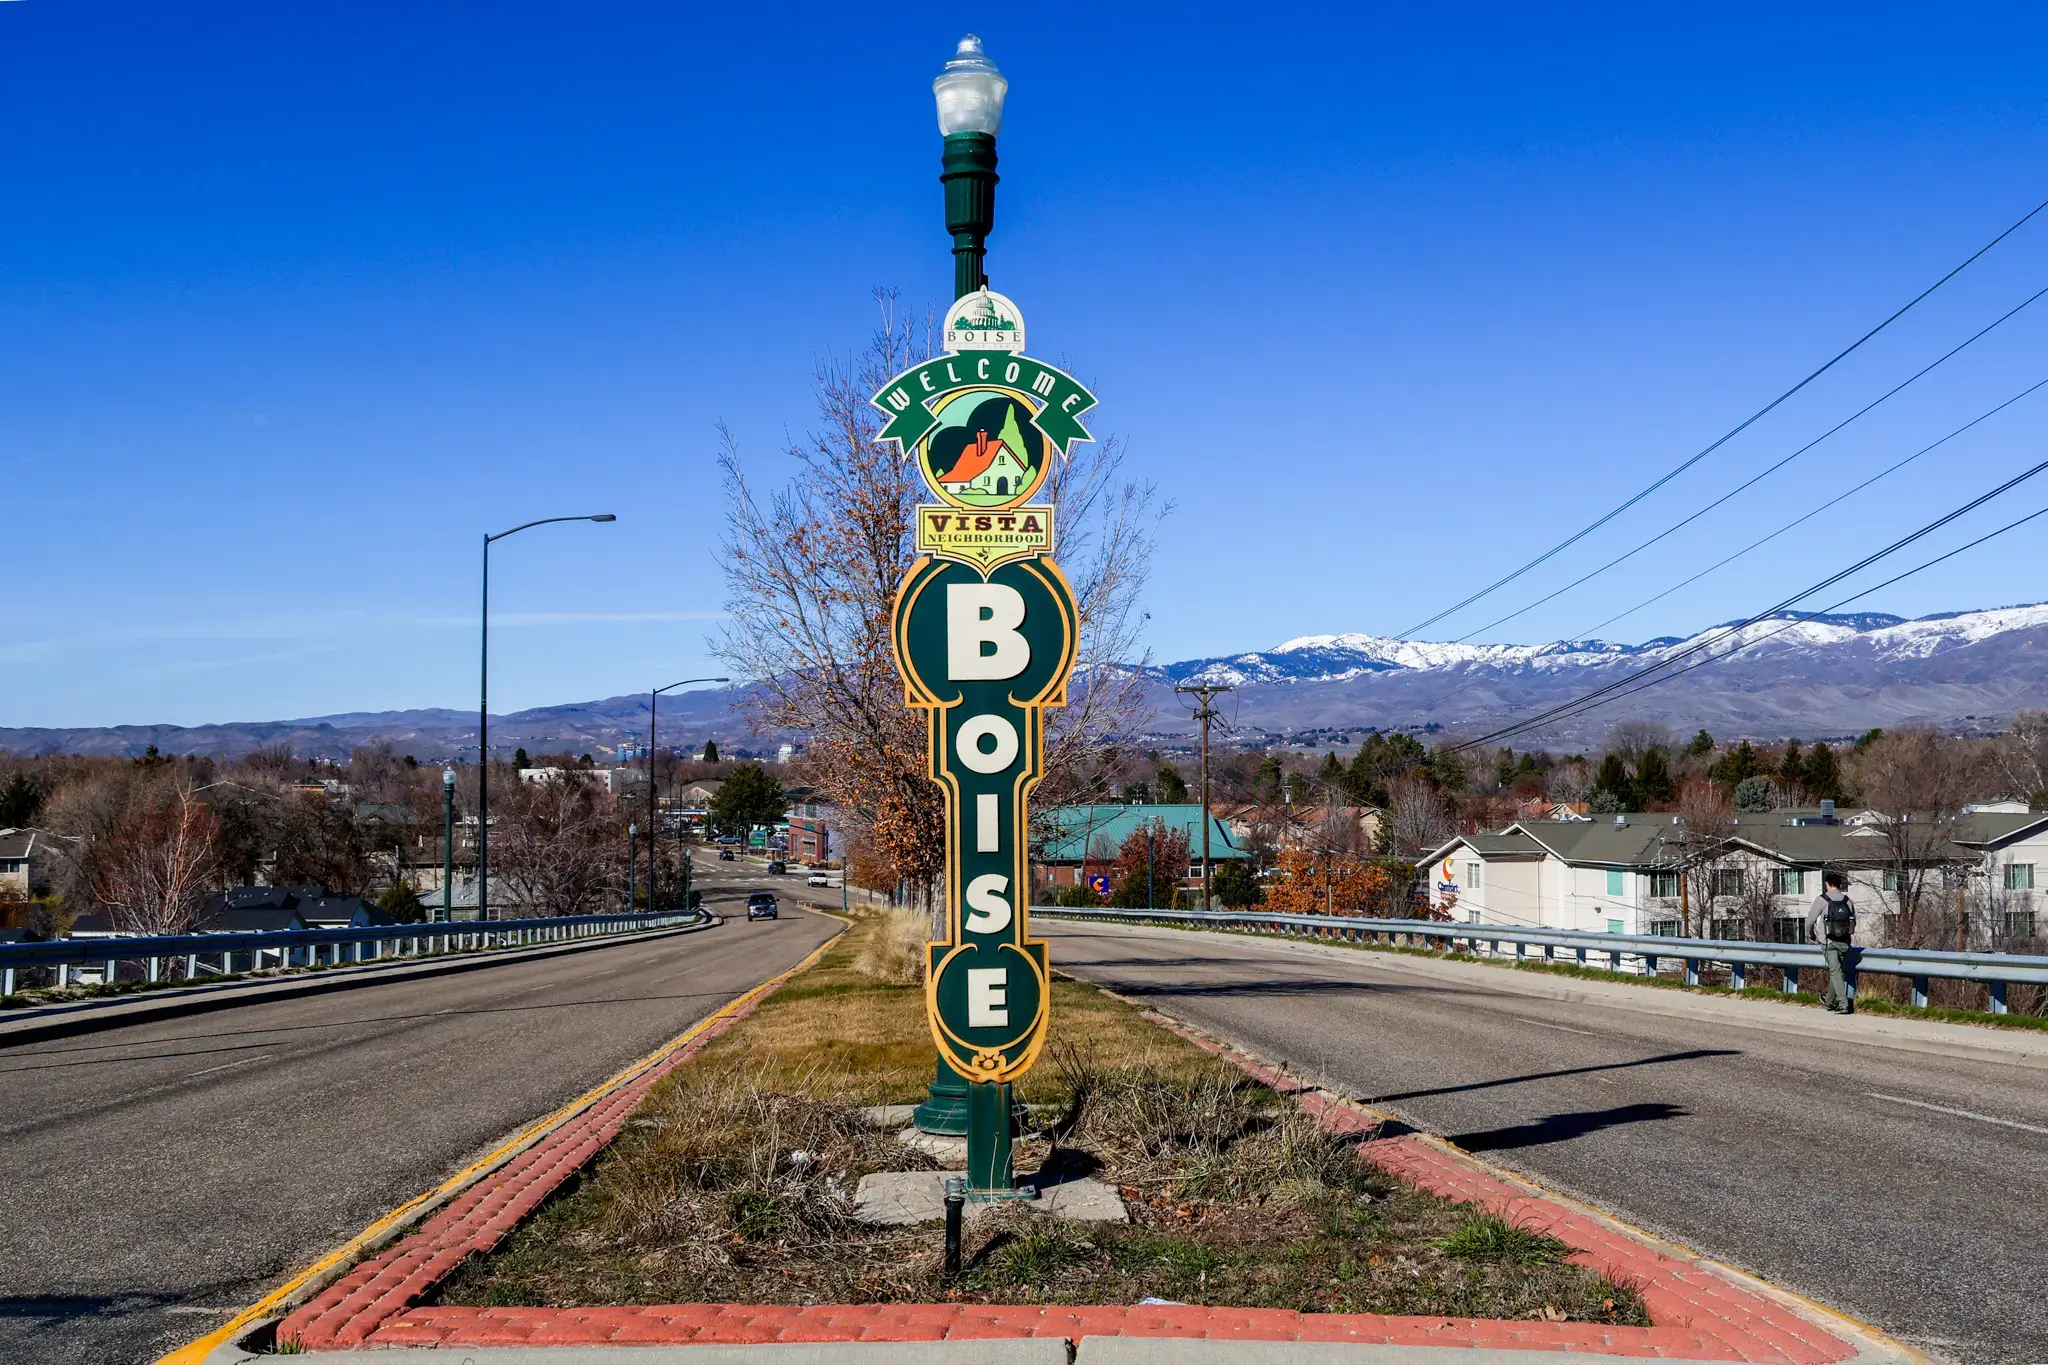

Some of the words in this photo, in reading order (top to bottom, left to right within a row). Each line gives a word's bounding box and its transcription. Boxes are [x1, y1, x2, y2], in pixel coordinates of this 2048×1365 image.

[947, 331, 1022, 342] BOISE
[886, 358, 1081, 414] WELCOME
[927, 514, 1044, 533] VISTA
[928, 534, 1044, 543] NEIGHBORHOOD
[946, 582, 1031, 1028] BOISE
